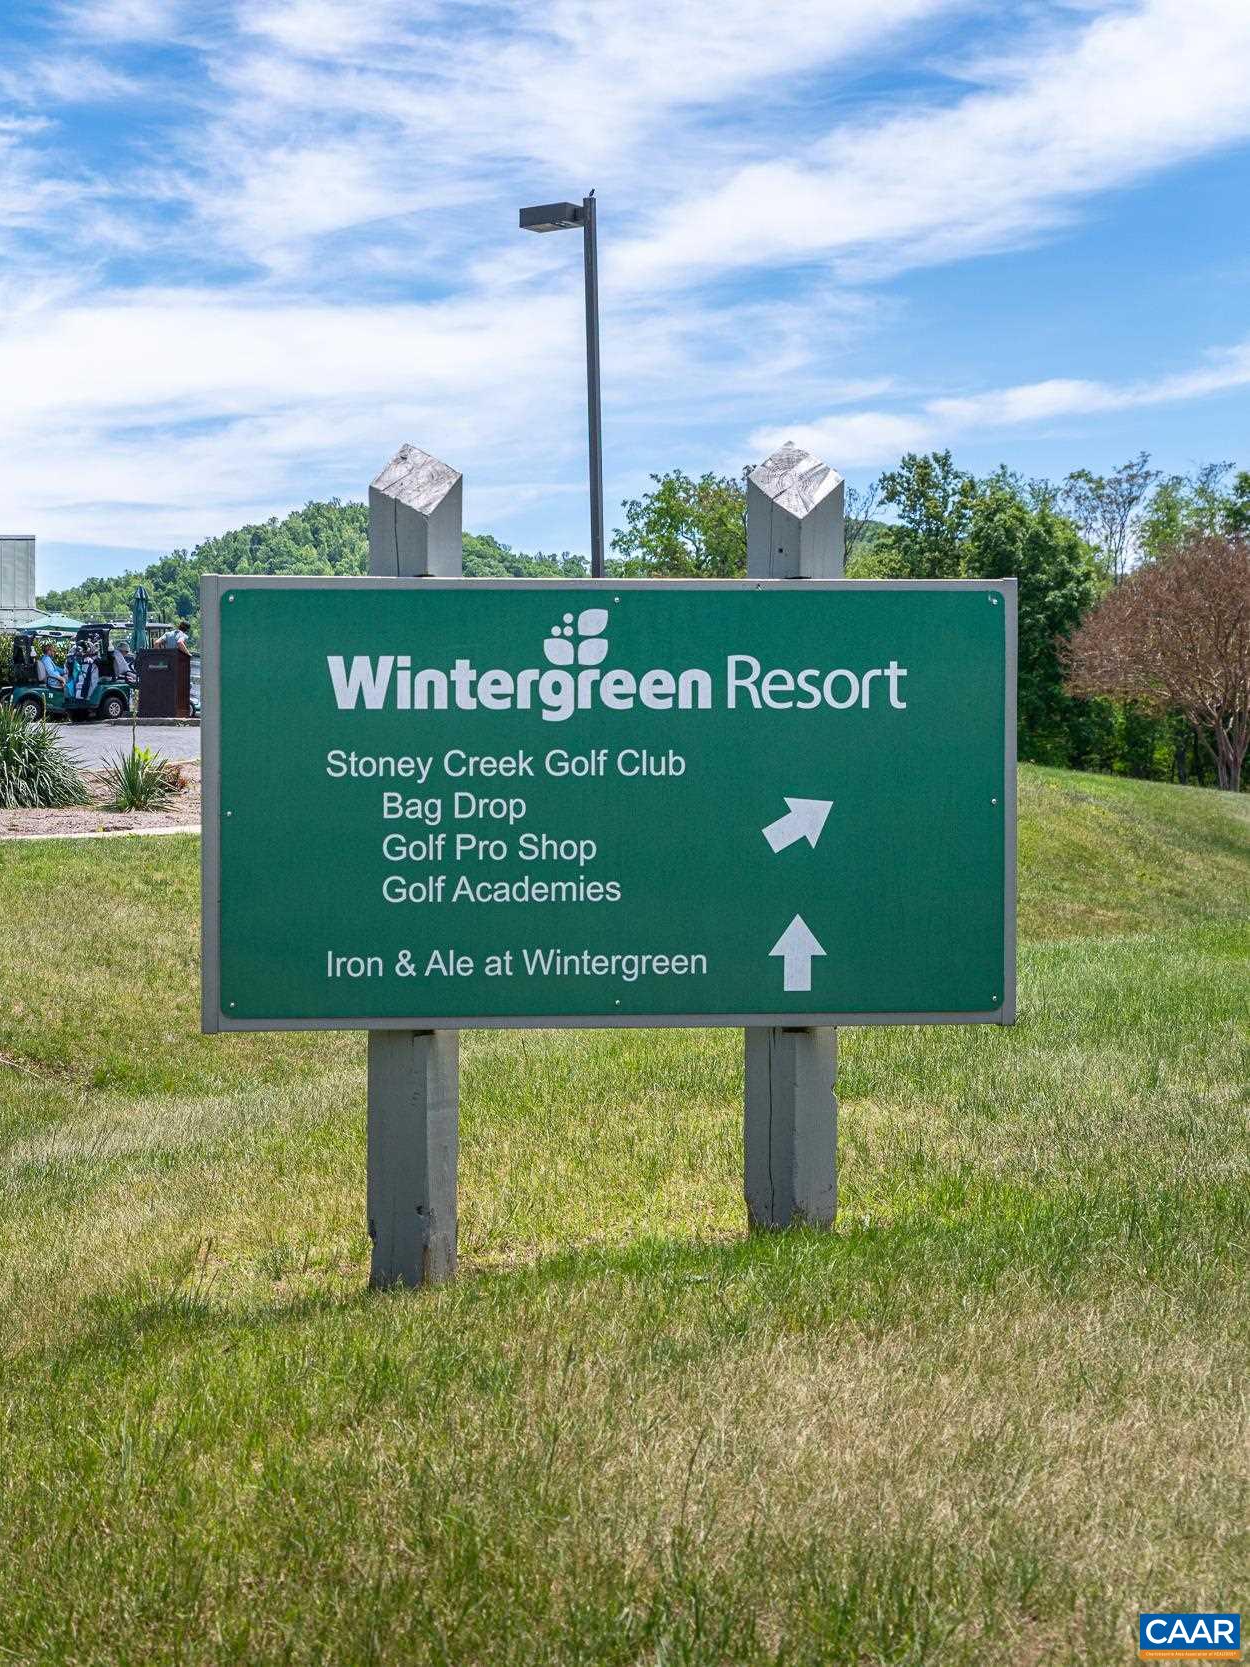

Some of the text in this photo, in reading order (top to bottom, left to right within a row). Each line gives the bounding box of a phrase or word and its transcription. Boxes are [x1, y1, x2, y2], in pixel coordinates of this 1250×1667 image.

[327, 654, 908, 722] Wintergreen Resort
[326, 748, 686, 784] Stoney Creek Golf Club
[383, 791, 527, 826] Bag Drop
[382, 832, 597, 867] Golf Pro Shop
[382, 875, 622, 903] Golf Academies
[327, 948, 707, 982] Iron & Ale at Wintergreen
